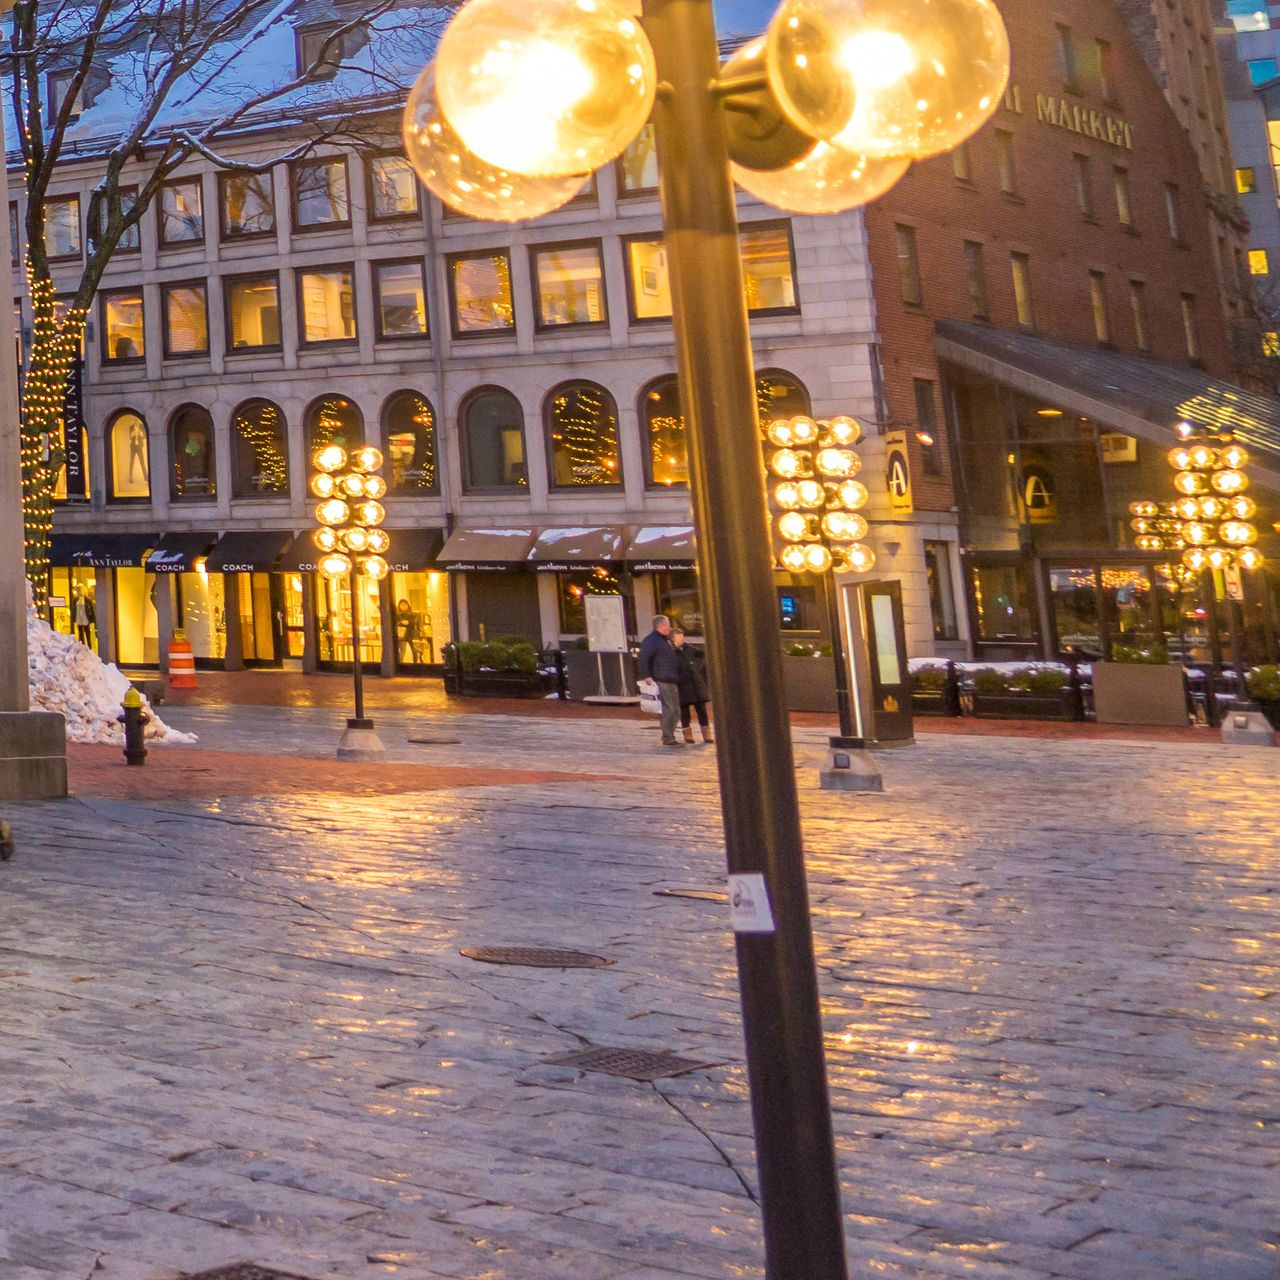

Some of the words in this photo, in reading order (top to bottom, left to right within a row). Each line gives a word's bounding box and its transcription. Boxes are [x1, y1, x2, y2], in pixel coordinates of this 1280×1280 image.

[1036, 92, 1134, 151] MARKET
[155, 563, 185, 571] COACH
[222, 563, 254, 571] COACH
[298, 563, 318, 571] COA
[390, 563, 409, 571] ACH
